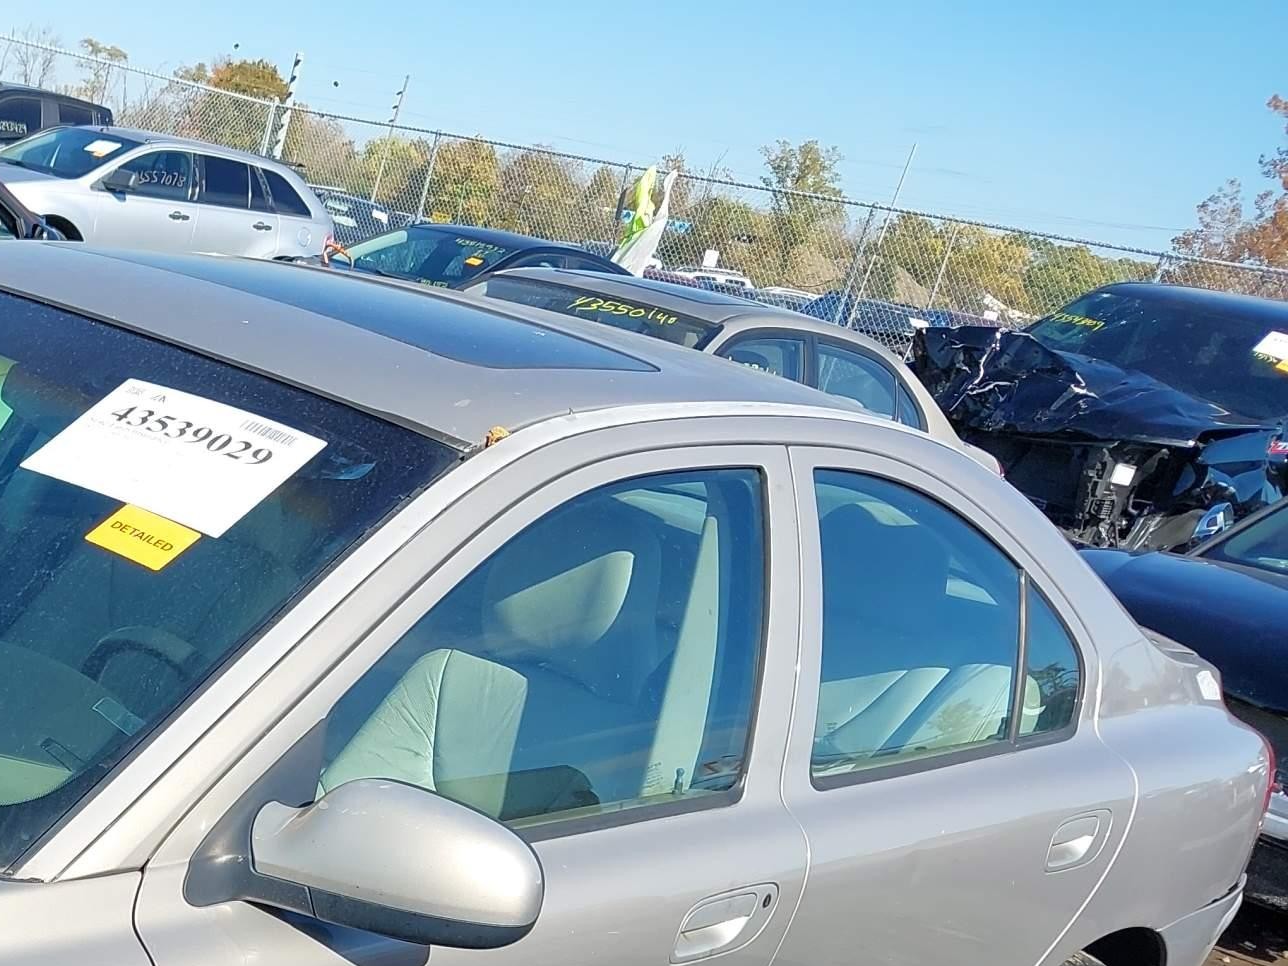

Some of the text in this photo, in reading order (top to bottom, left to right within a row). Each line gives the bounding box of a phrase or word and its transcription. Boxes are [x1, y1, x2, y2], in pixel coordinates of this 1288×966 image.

[566, 296, 679, 325] 43550140
[112, 406, 273, 464] 43539029
[110, 520, 174, 552] DETAILED
